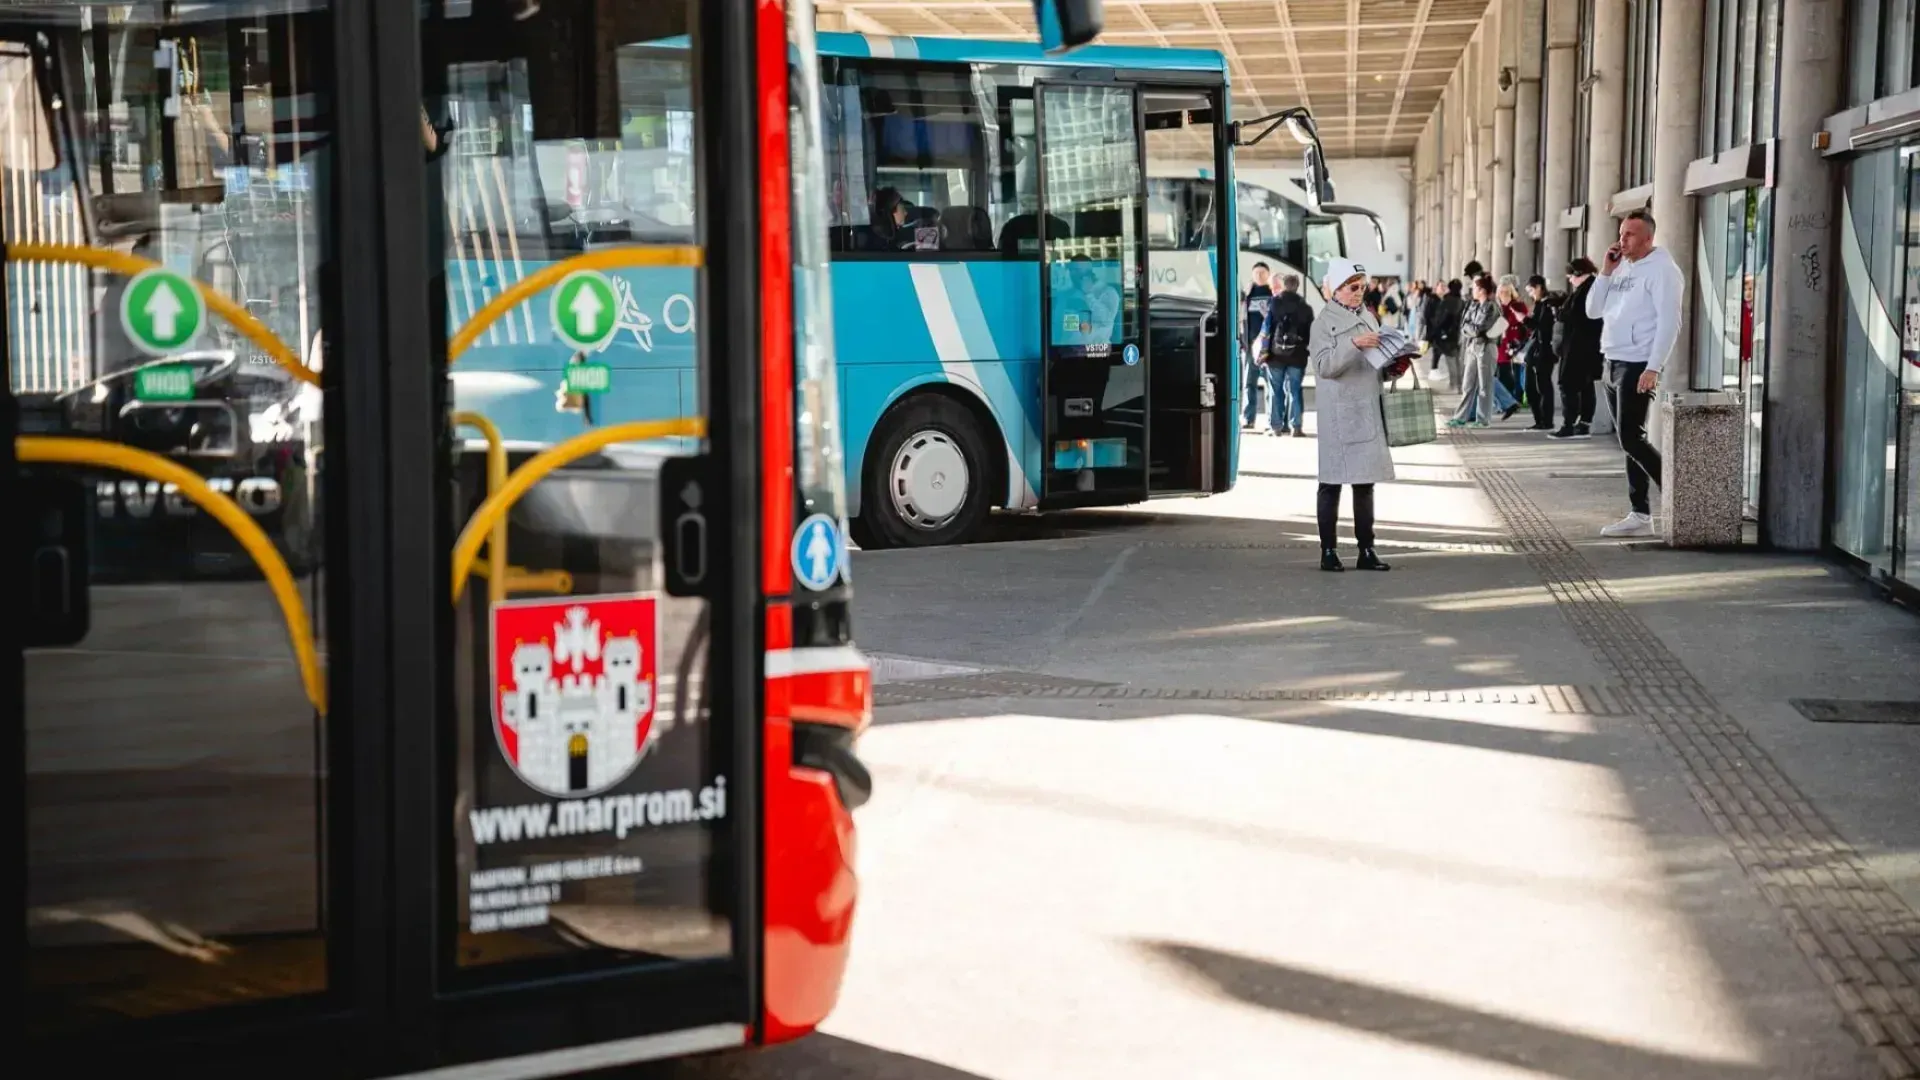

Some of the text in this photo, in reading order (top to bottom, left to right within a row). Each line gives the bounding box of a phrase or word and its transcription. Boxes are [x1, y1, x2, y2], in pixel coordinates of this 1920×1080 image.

[250, 355, 280, 364] IZSTO
[1085, 344, 1108, 352] VSTOP
[96, 477, 282, 517] IVEO
[469, 775, 726, 844] www.marprom.si
